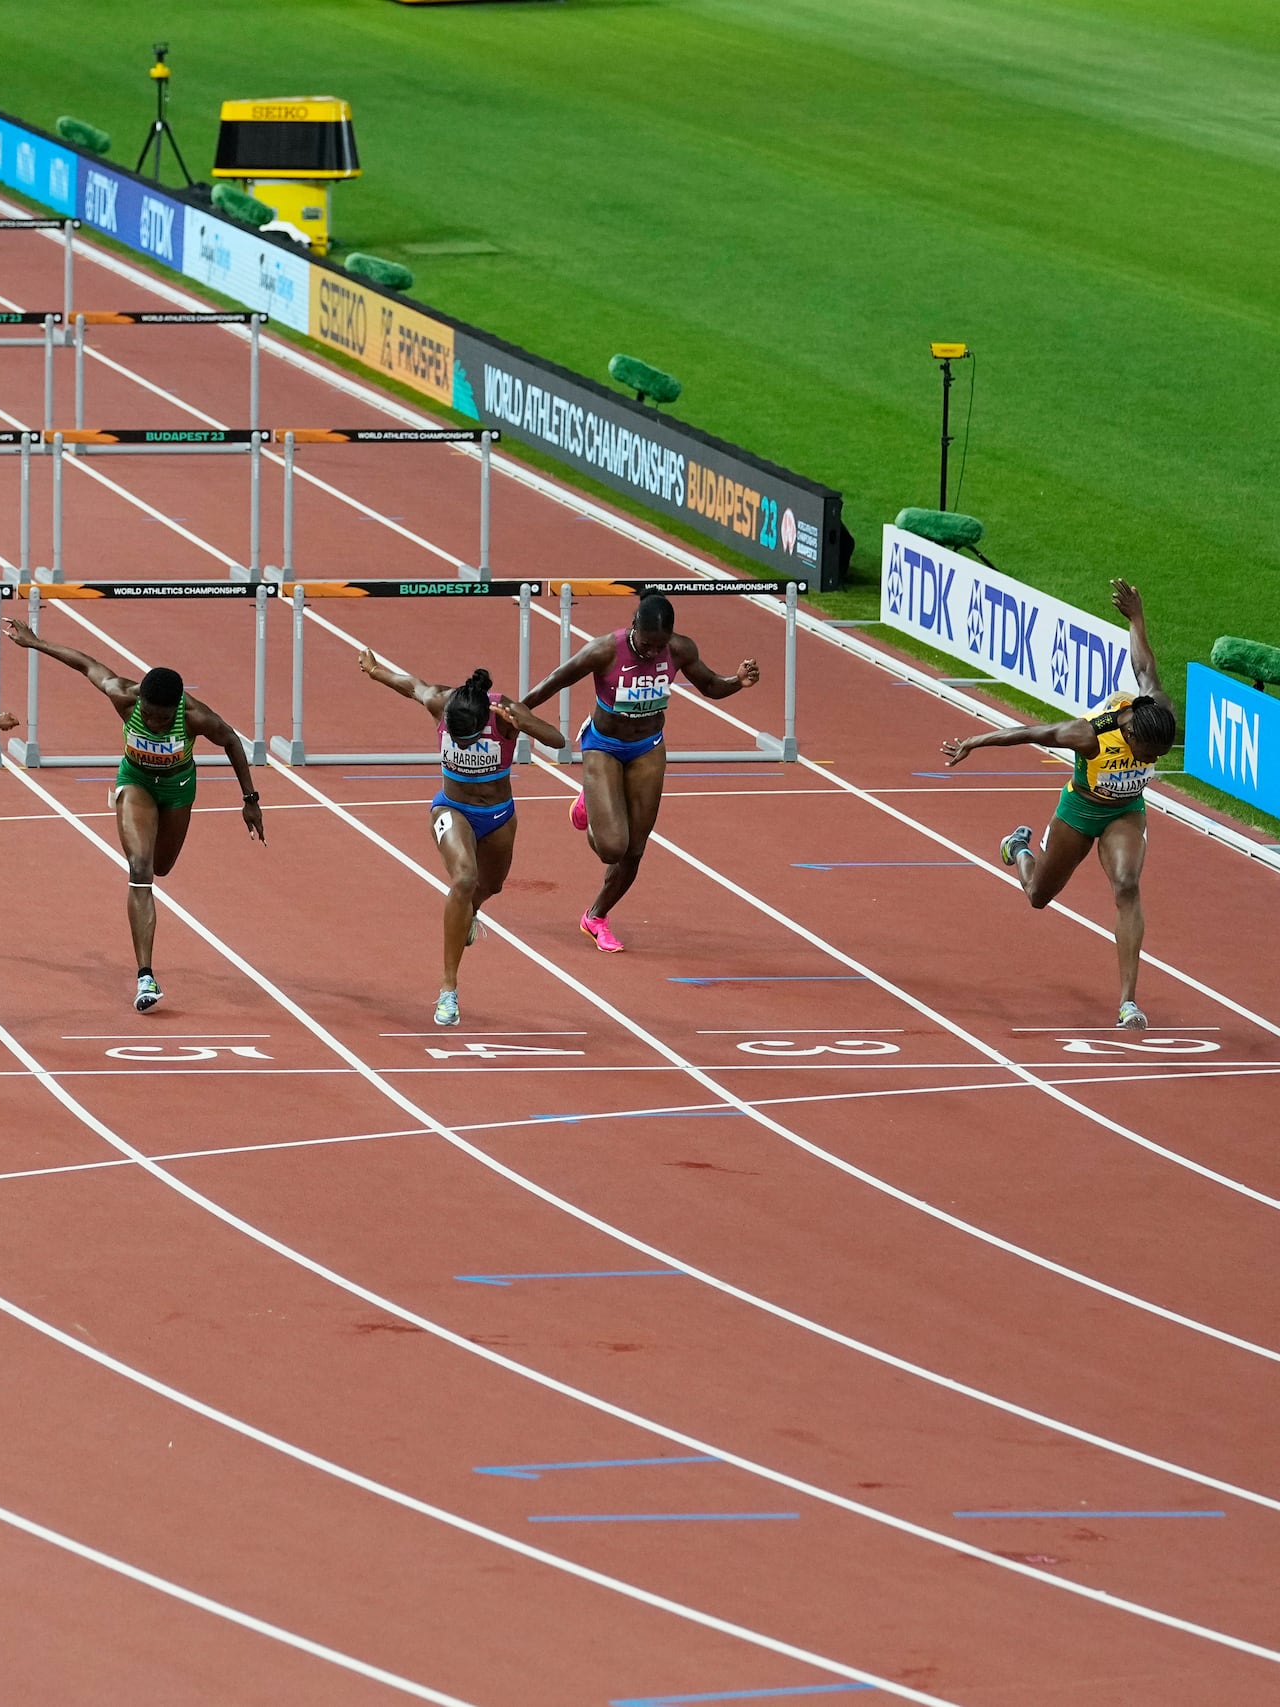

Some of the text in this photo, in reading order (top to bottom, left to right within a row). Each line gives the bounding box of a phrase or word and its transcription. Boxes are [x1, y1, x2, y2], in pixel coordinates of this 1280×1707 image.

[252, 105, 309, 120] SEIKO
[93, 172, 119, 233] TDK
[148, 198, 175, 261] TDK
[11, 314, 22, 323] 23
[320, 278, 368, 356] SEIKO
[398, 325, 451, 391] PROSPEX
[146, 431, 224, 441] BUDAPEST 23
[357, 432, 474, 440] WORLD ATHLETICS CHAMPIONSHIPS
[484, 364, 524, 427] WORLD
[523, 384, 585, 457] ATHLETICS
[585, 411, 685, 507] CHAMPIONSHIPS
[687, 461, 760, 541] BUDAPEST
[760, 496, 778, 550] 23
[113, 587, 246, 595] WORLD ATHLETICS CHAMPIONSHIPS
[400, 583, 489, 595] BUDAPEST 23
[645, 583, 778, 591] WORLD ATHLETICS CHAMPIONSHIPS
[904, 547, 956, 641] TDK
[985, 584, 1040, 683] TDK
[1069, 623, 1128, 710] TDK
[618, 675, 669, 690] USA
[628, 686, 663, 700] NTN
[632, 701, 654, 711] ALI
[136, 738, 173, 754] NTN
[1208, 692, 1260, 791] NTN
[130, 750, 180, 765] AMUSAN
[453, 751, 498, 767] HARRISON
[1110, 768, 1147, 782] NTN
[105, 1045, 274, 1061] 5
[425, 1043, 585, 1059] 4
[736, 1040, 901, 1056] 3
[1055, 1038, 1221, 1054] 2
